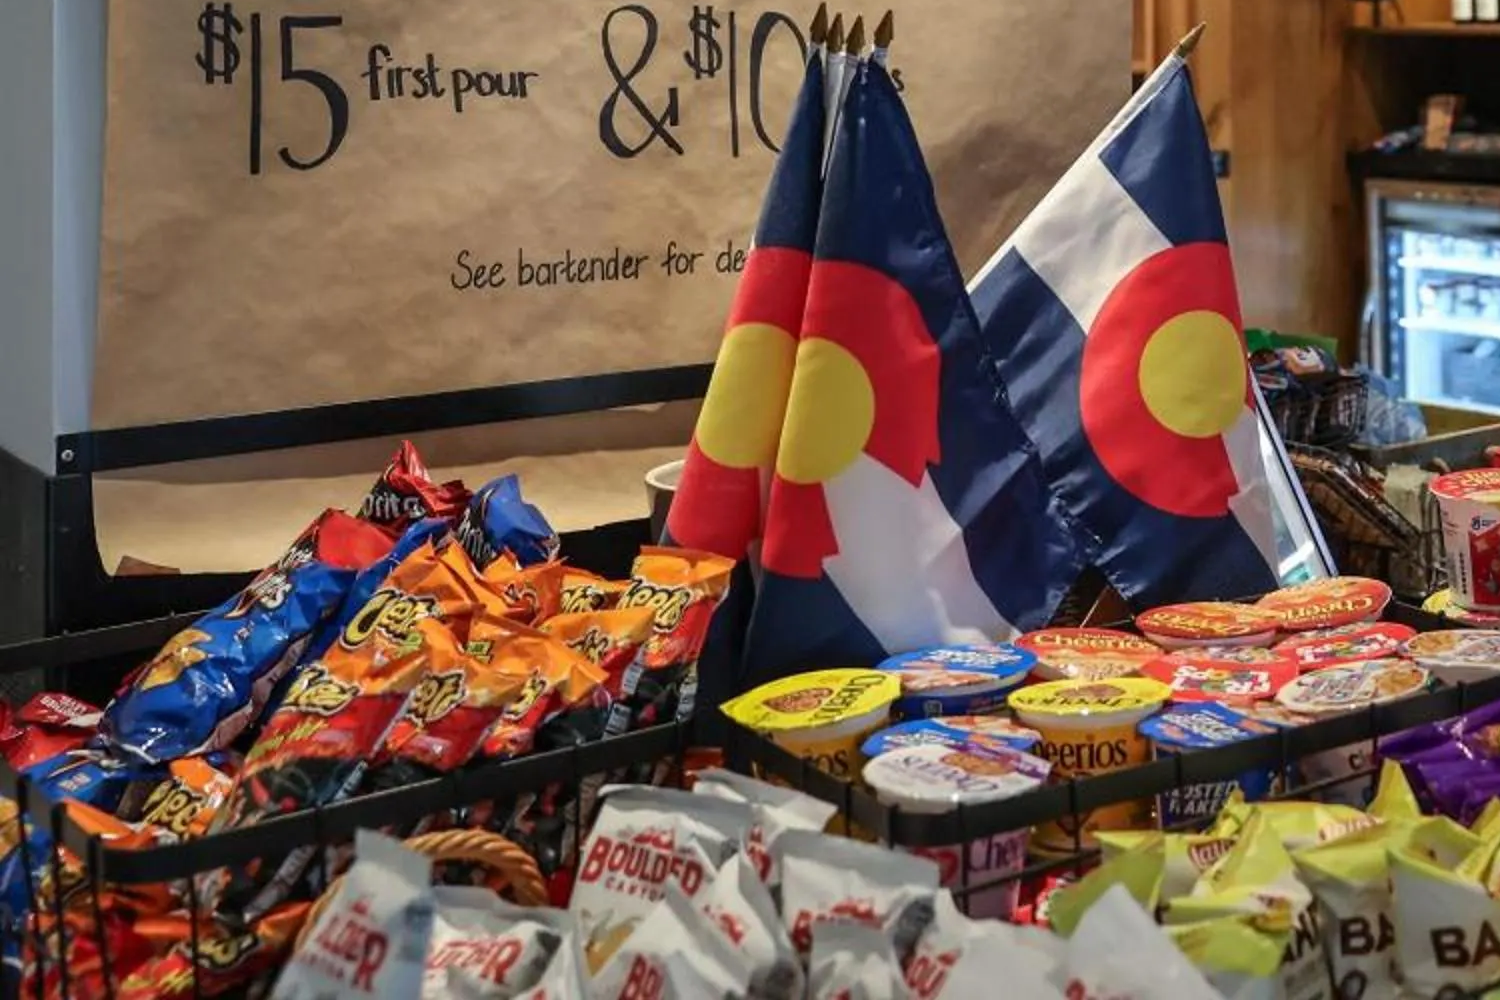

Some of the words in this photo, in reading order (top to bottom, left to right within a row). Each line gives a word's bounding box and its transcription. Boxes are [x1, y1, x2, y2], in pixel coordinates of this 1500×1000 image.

[194, 2, 350, 176] $15
[361, 43, 446, 101] first
[451, 68, 540, 114] pour
[599, 4, 684, 160] &
[451, 249, 506, 290] See
[517, 247, 650, 287] bartender
[660, 240, 705, 276] for
